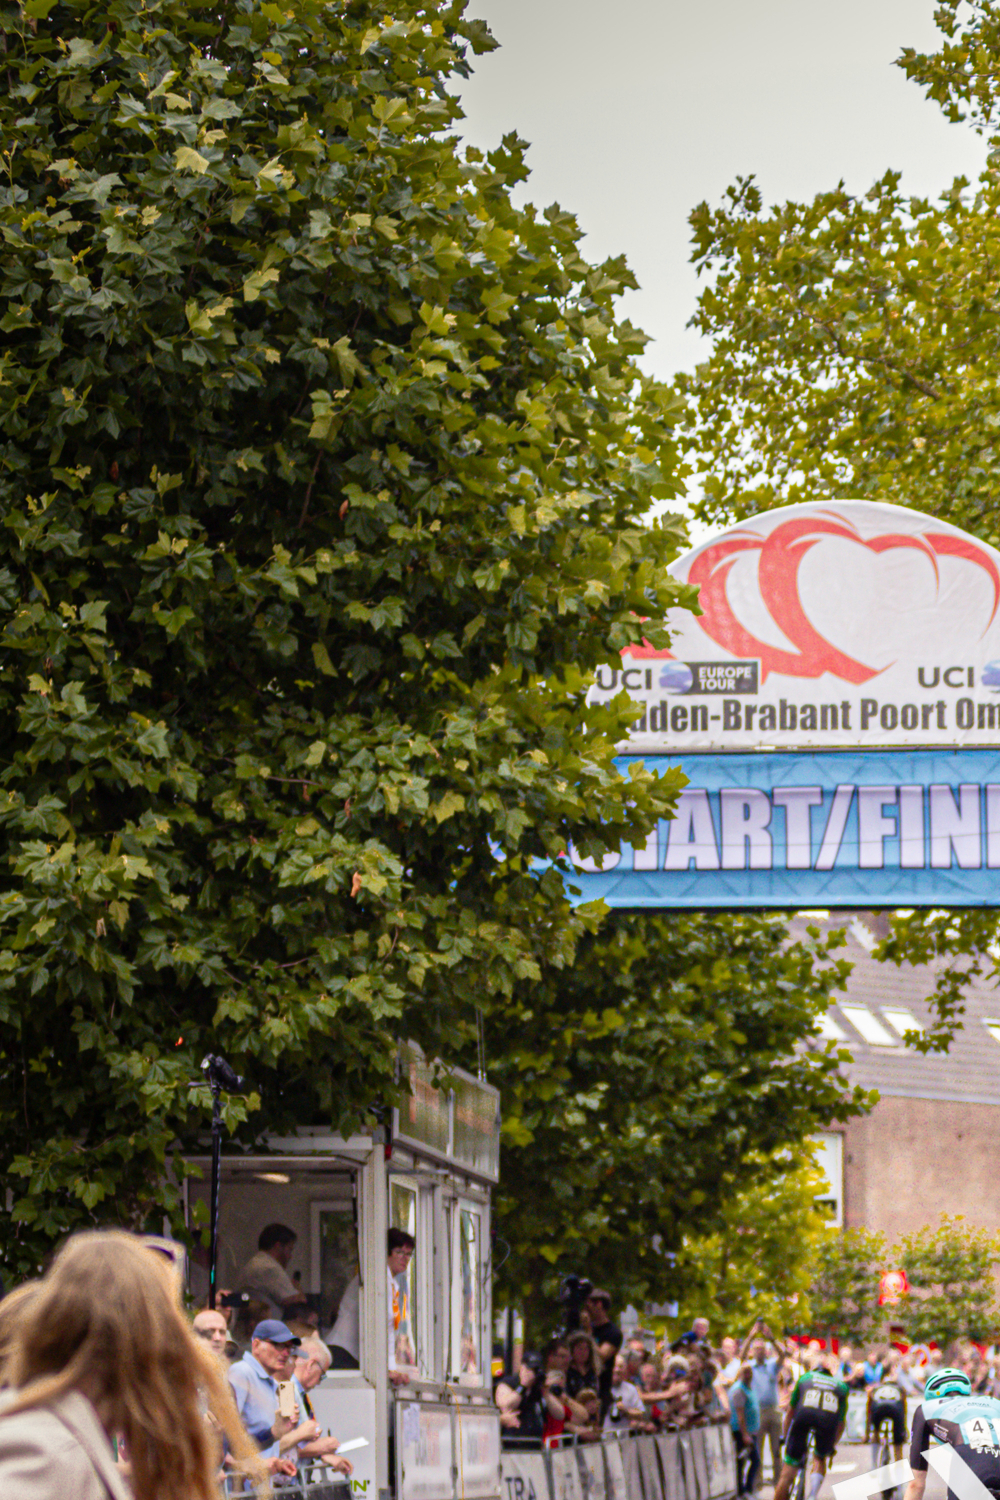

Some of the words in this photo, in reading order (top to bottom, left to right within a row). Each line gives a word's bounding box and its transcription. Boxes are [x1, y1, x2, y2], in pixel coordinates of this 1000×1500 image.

[597, 668, 652, 690] UCI
[698, 665, 753, 680] EUROPE
[917, 666, 975, 689] UCI
[698, 678, 736, 691] TOUR
[861, 698, 948, 731] Poort
